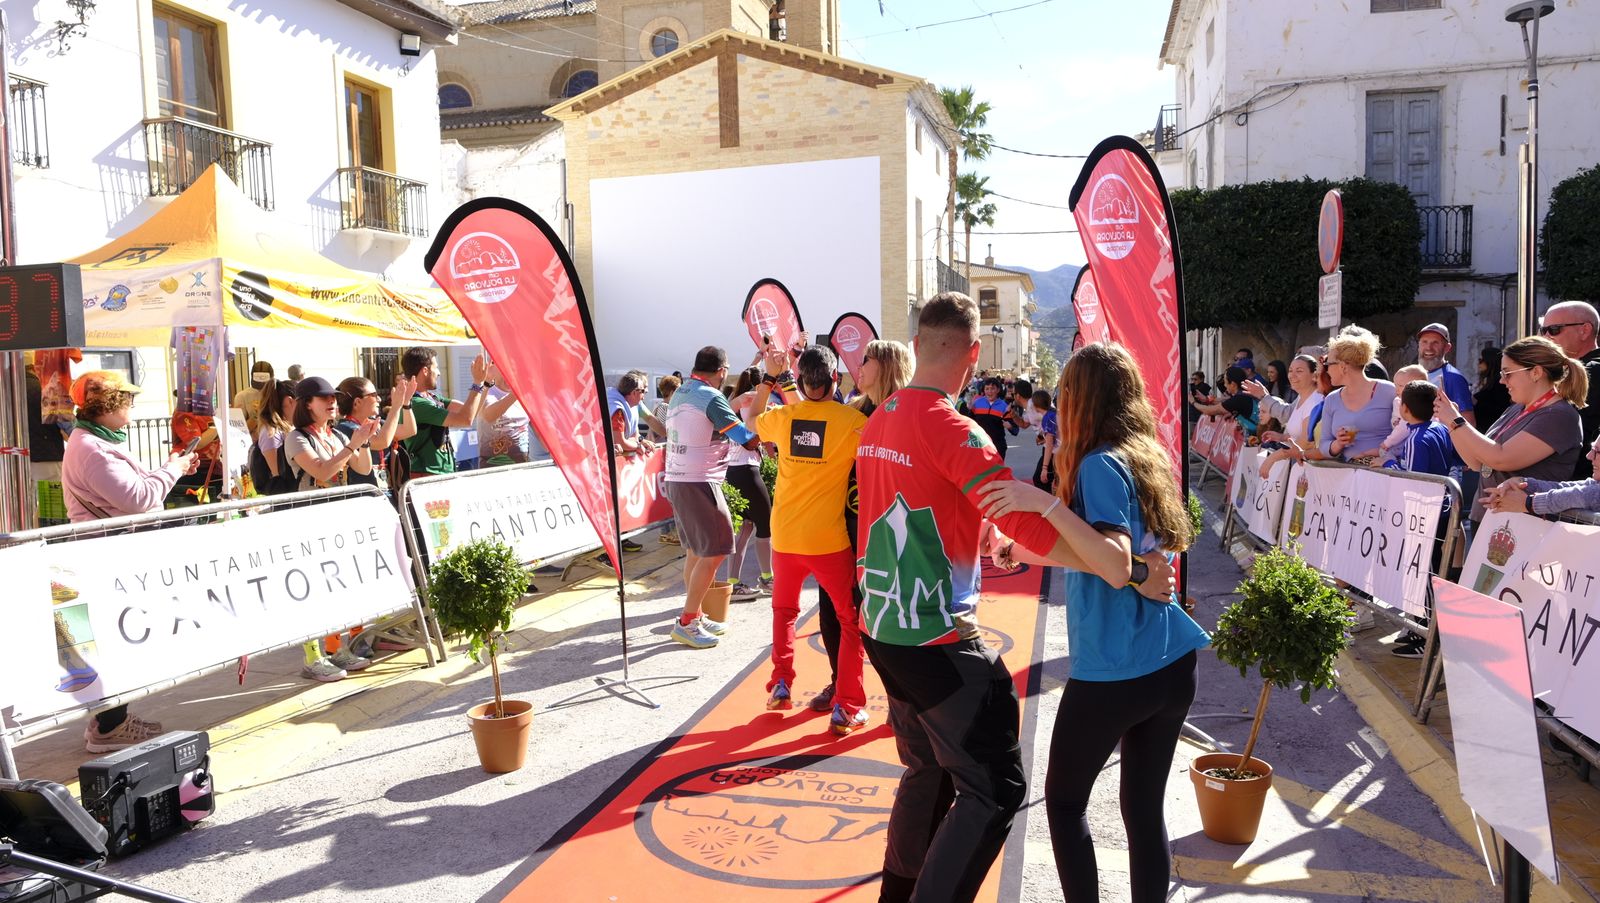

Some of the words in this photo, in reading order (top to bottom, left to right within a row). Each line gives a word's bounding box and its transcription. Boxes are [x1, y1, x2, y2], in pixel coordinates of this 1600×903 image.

[184, 290, 212, 298] DRONE
[469, 501, 585, 547] CANTORI
[1304, 511, 1423, 579] CANTORIA
[1409, 513, 1426, 535] DE
[114, 533, 345, 594] AYUNTAMIENTO
[354, 525, 380, 545] DE
[118, 548, 394, 645] CANTORIA
[708, 770, 880, 797] POLVORA
